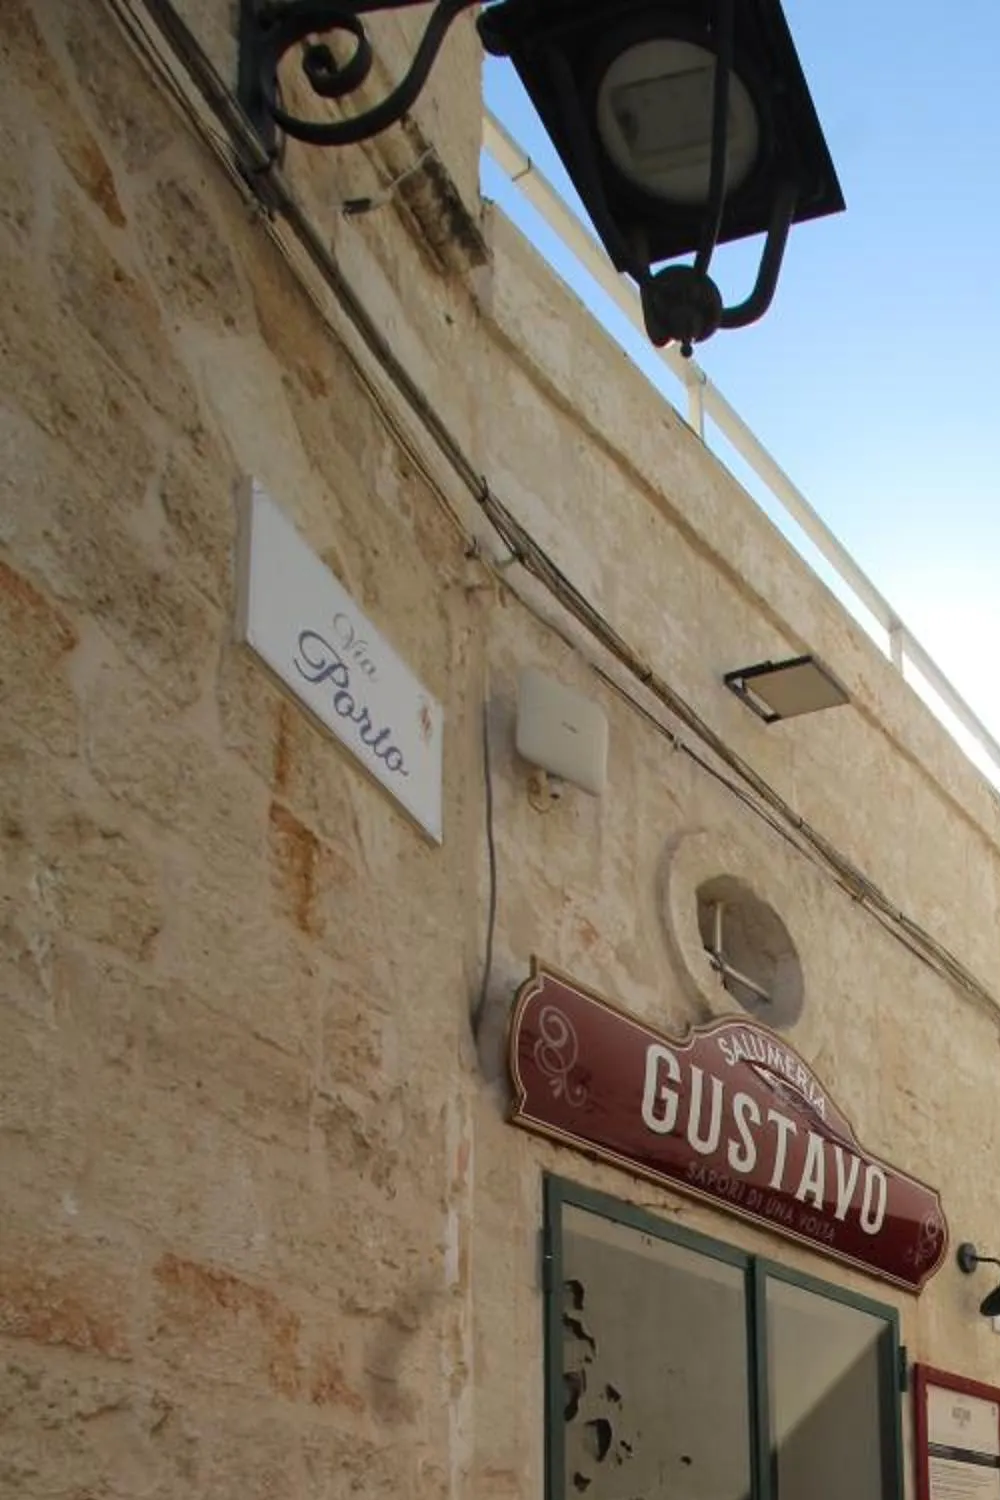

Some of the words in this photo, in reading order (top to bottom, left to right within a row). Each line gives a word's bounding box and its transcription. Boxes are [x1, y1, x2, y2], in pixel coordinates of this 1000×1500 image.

[333, 613, 378, 682] Via
[294, 630, 409, 776] Porto
[717, 1033, 826, 1121] SALUMERIA
[641, 1044, 888, 1236] GUSTAVO
[687, 1161, 746, 1201] SAPORI
[748, 1188, 763, 1208] DI
[765, 1193, 795, 1225] UNA
